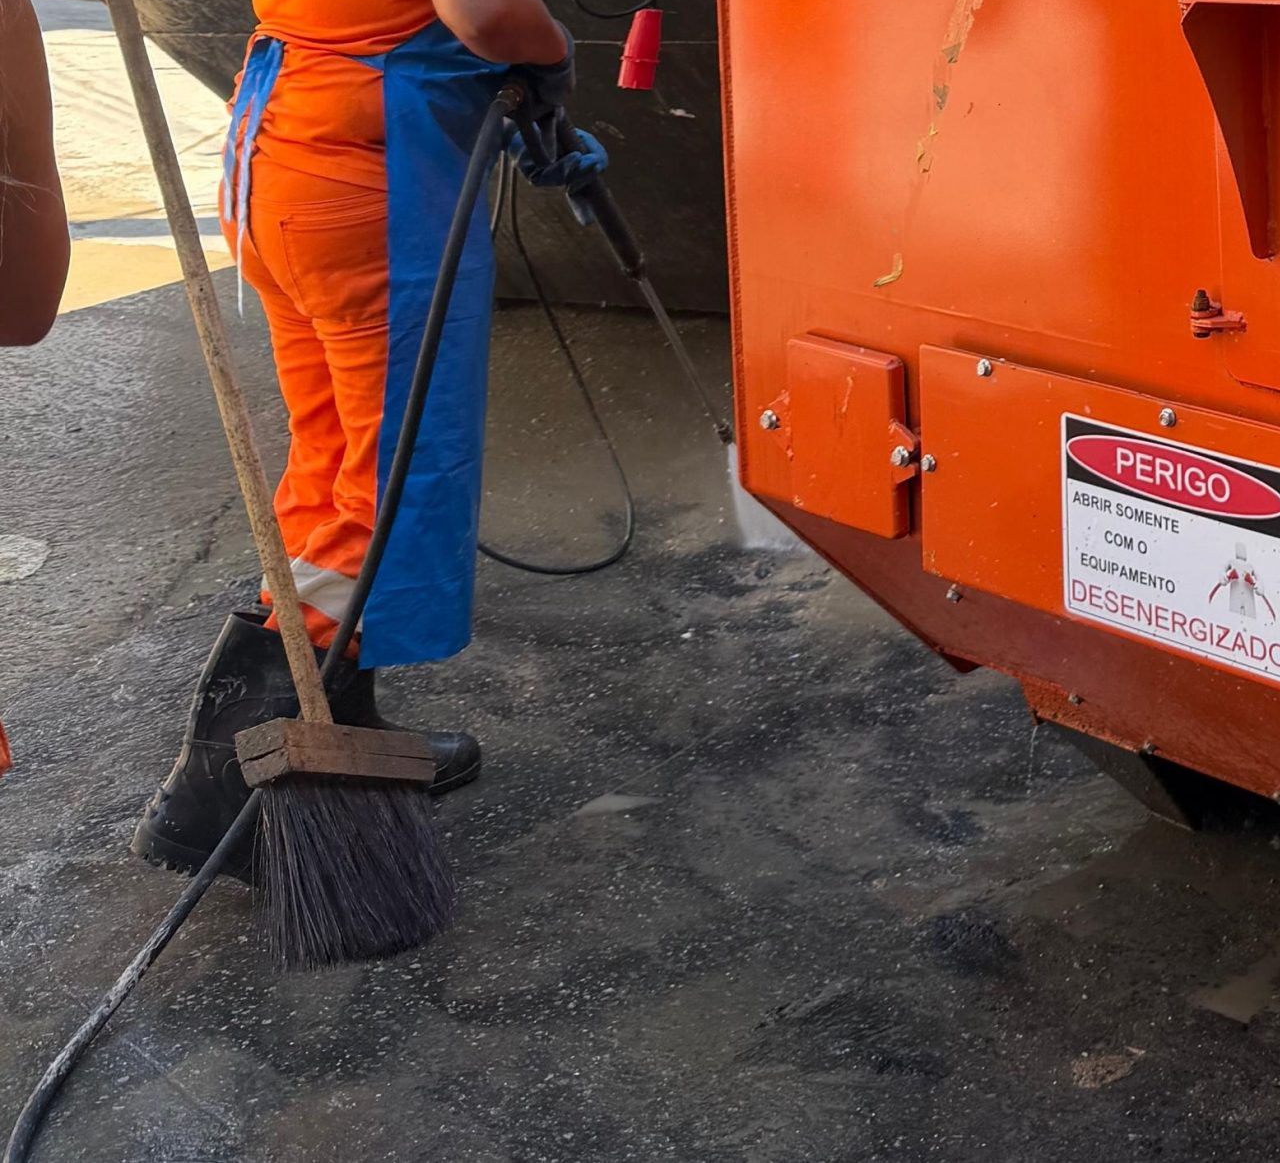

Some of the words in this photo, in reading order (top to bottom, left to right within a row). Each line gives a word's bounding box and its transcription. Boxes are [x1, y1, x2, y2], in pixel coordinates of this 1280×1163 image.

[1116, 446, 1231, 503] PERIGO
[1072, 490, 1112, 515] ABRIR
[1116, 503, 1180, 534] SOMENTE
[1104, 530, 1134, 551] COM
[1137, 540, 1148, 555] O
[1081, 552, 1176, 594] EQUIPAMENTO
